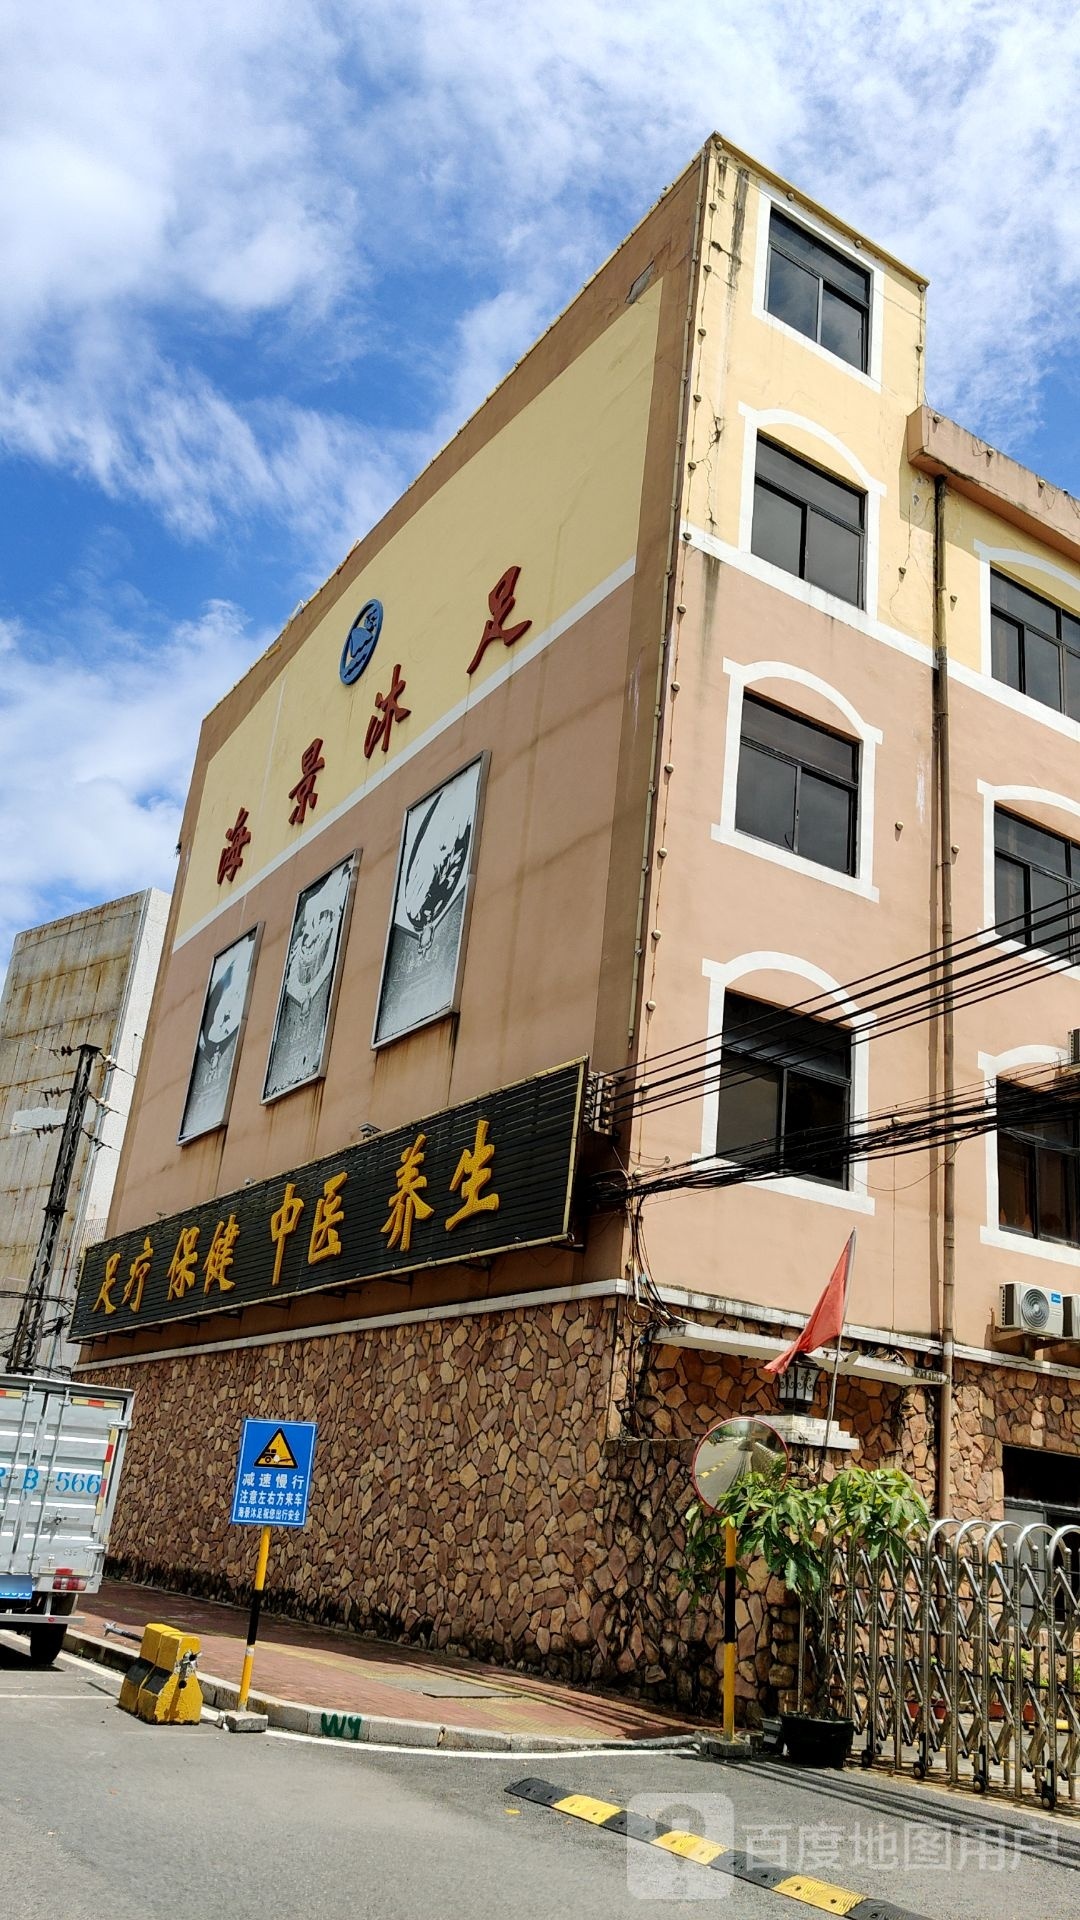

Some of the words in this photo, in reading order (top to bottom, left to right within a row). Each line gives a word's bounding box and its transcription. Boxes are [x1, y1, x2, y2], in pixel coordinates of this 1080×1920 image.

[242, 1472, 304, 1489] 减速慢行
[239, 1490, 303, 1507] 注意左右方来车
